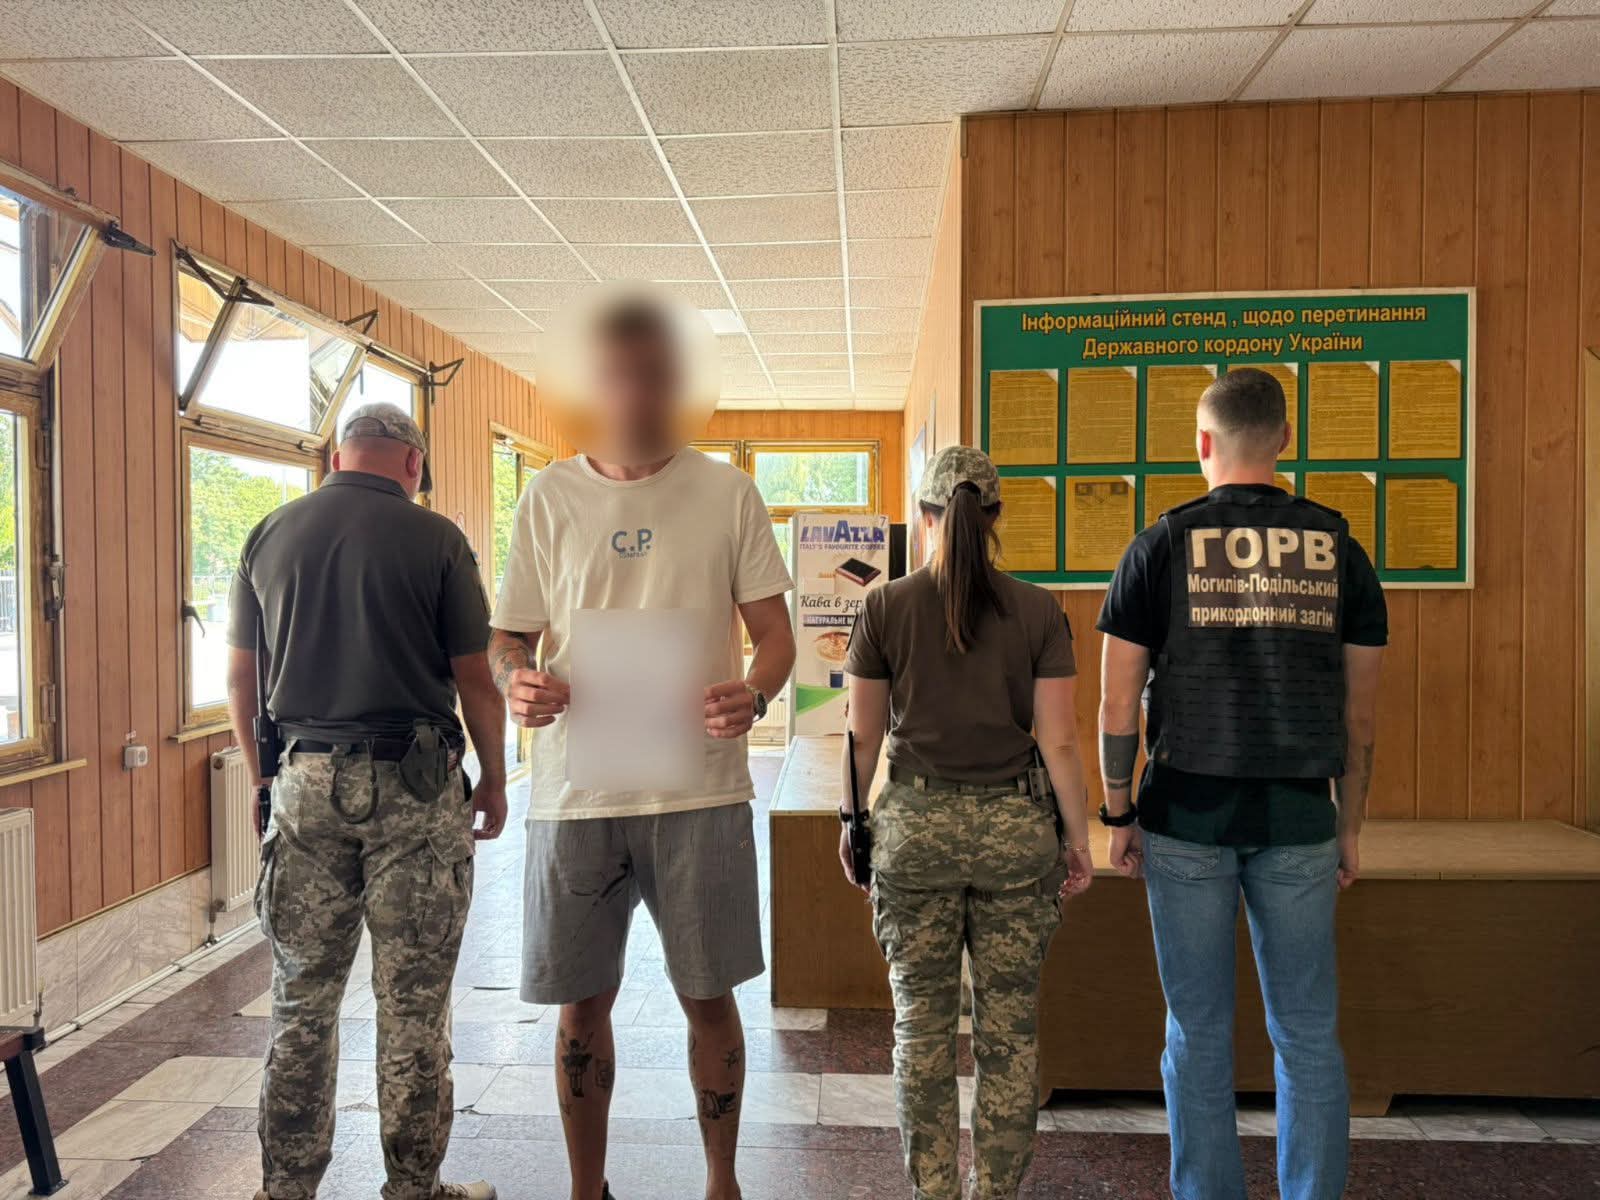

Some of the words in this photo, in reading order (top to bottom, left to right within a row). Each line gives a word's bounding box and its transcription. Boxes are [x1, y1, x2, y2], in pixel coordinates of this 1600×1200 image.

[1021, 309, 1167, 334] Інформаційний
[1171, 310, 1227, 328] стенд
[1243, 309, 1295, 326] щодо
[1301, 306, 1426, 327] перетинання
[1082, 337, 1199, 361] Державного
[1204, 337, 1284, 357] кордону
[1288, 332, 1364, 352] України
[612, 529, 652, 552] C.P.
[800, 520, 885, 542] LAVAZZA
[1191, 527, 1336, 570] ГОРВ
[1187, 573, 1339, 598] Могилів-Подільський
[800, 595, 831, 608] Кава
[834, 596, 841, 608] в
[842, 600, 863, 613] зер
[1191, 603, 1297, 627] прикордонний
[1300, 606, 1334, 628] загін
